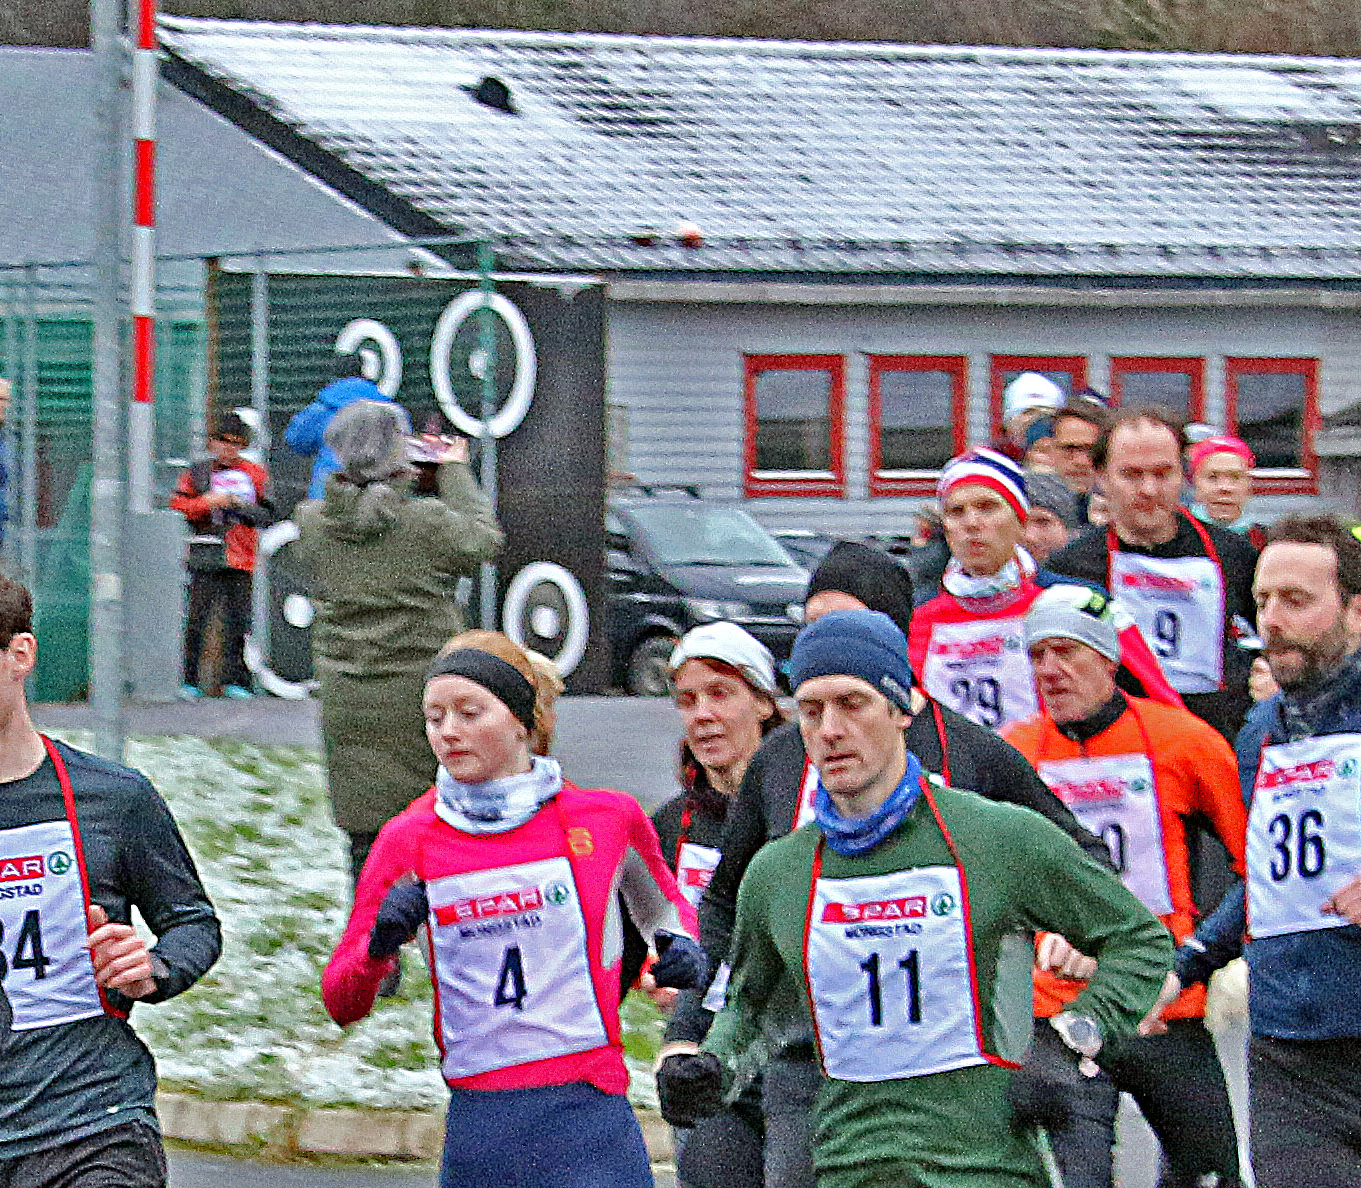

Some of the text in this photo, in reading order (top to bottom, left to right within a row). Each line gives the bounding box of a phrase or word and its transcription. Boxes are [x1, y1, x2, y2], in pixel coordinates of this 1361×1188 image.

[1155, 607, 1180, 658] 9
[1268, 810, 1326, 882] 36
[455, 888, 541, 919] SPAR
[842, 898, 925, 920] SPAR
[494, 944, 527, 1011] 4
[860, 948, 921, 1027] 11
